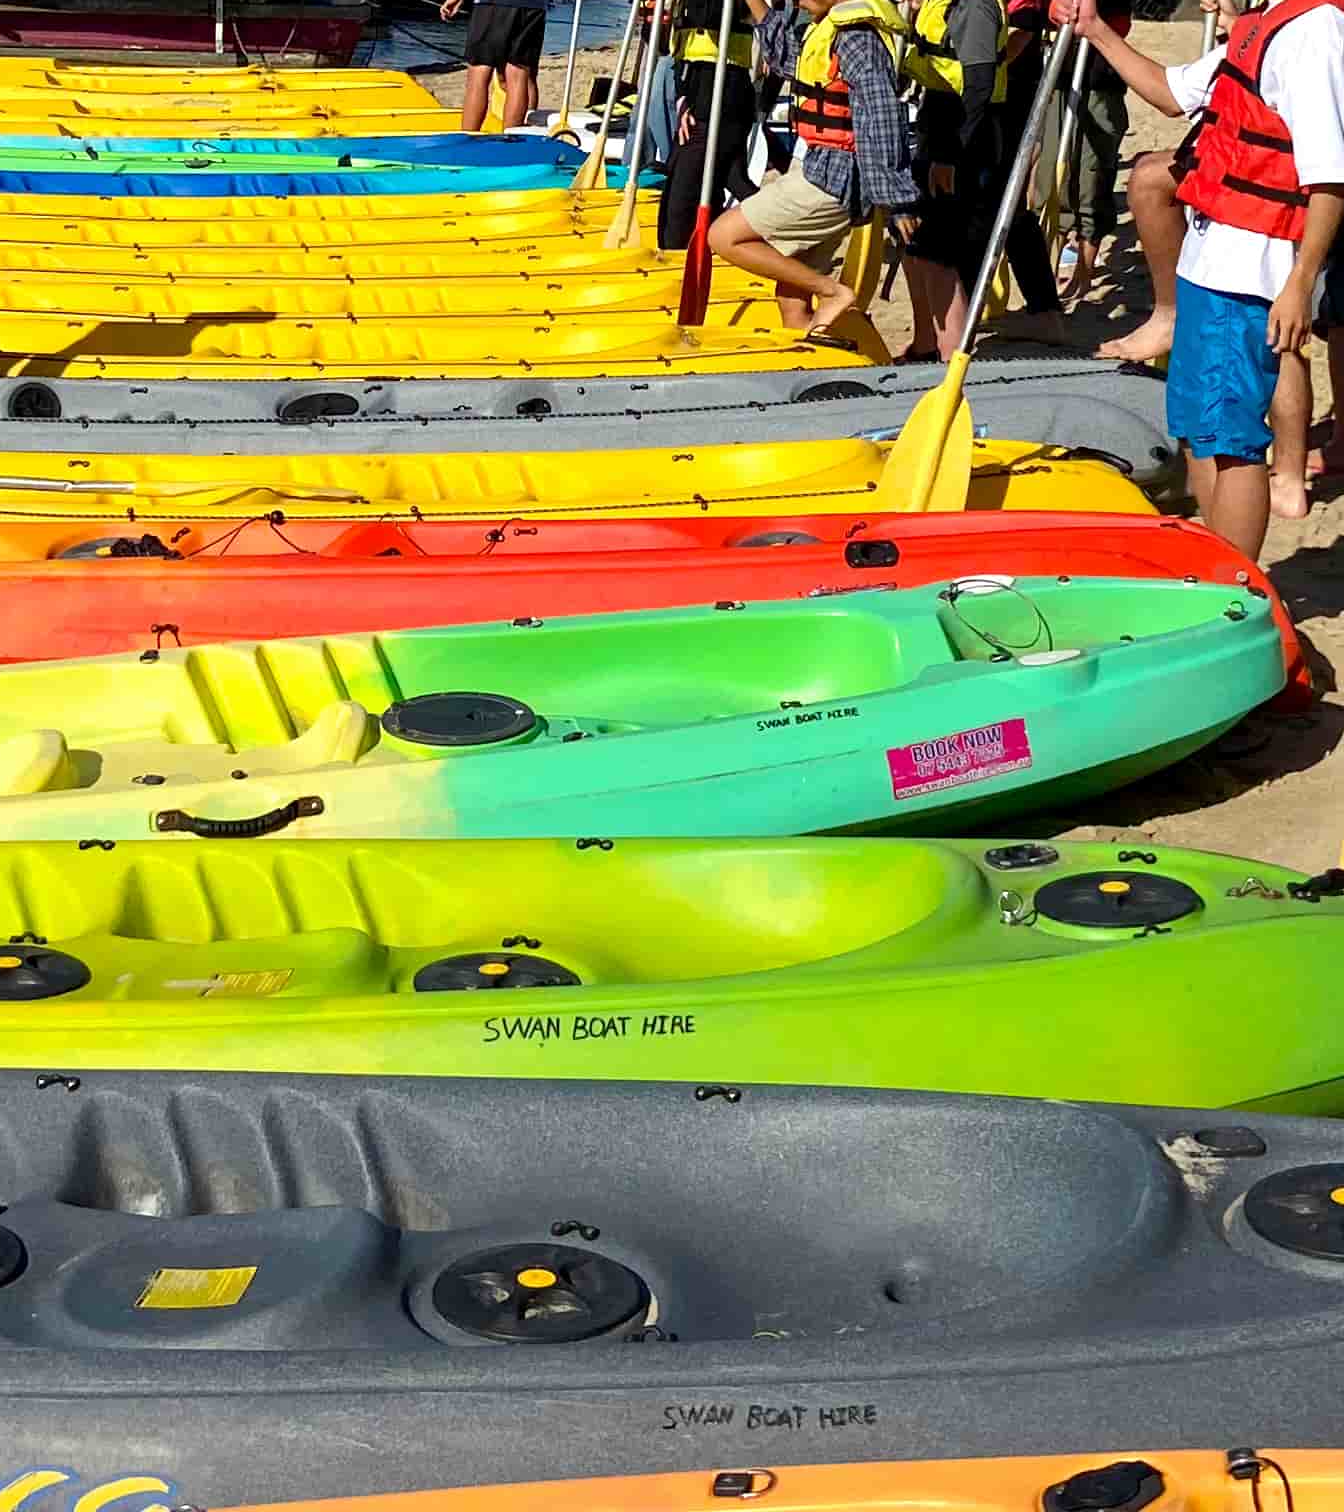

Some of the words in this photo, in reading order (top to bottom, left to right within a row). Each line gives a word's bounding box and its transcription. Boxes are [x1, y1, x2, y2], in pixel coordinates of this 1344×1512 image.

[756, 716, 791, 732] SWAN
[795, 711, 823, 725] BOAT
[827, 707, 861, 719] HIRE
[912, 737, 959, 762] BOOK
[963, 726, 1002, 750] NOW
[483, 1017, 561, 1042] SWAN
[572, 1016, 632, 1040] BOAT
[642, 1015, 696, 1035] HIRE
[662, 1405, 734, 1430] SWAN
[746, 1405, 807, 1429] BOAT
[818, 1404, 878, 1429] HIRE
